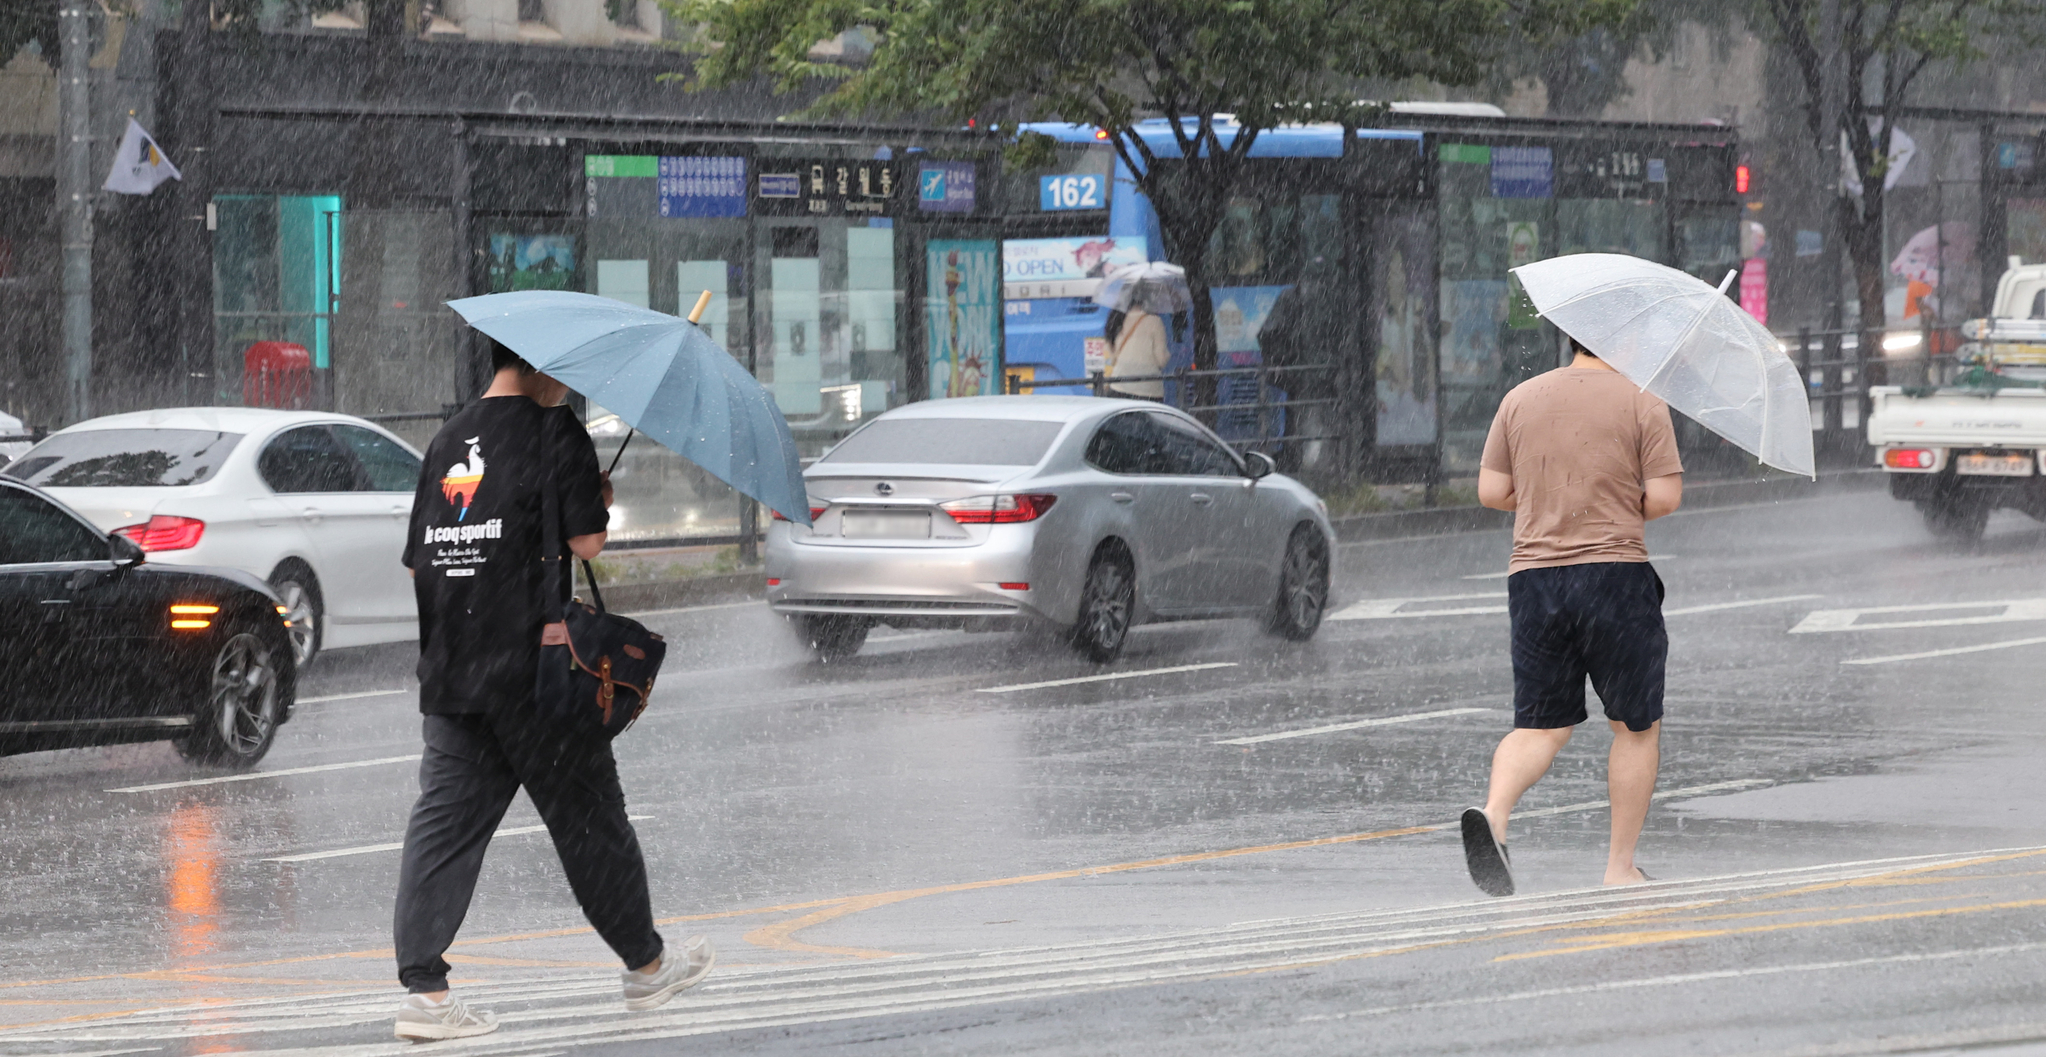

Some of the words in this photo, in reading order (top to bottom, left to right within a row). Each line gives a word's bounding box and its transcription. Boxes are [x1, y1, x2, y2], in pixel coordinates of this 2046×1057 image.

[1048, 176, 1096, 207] 162
[1017, 258, 1063, 276] OPEN
[424, 525, 434, 545] le
[434, 526, 461, 546] coq
[460, 518, 503, 545] sportif
